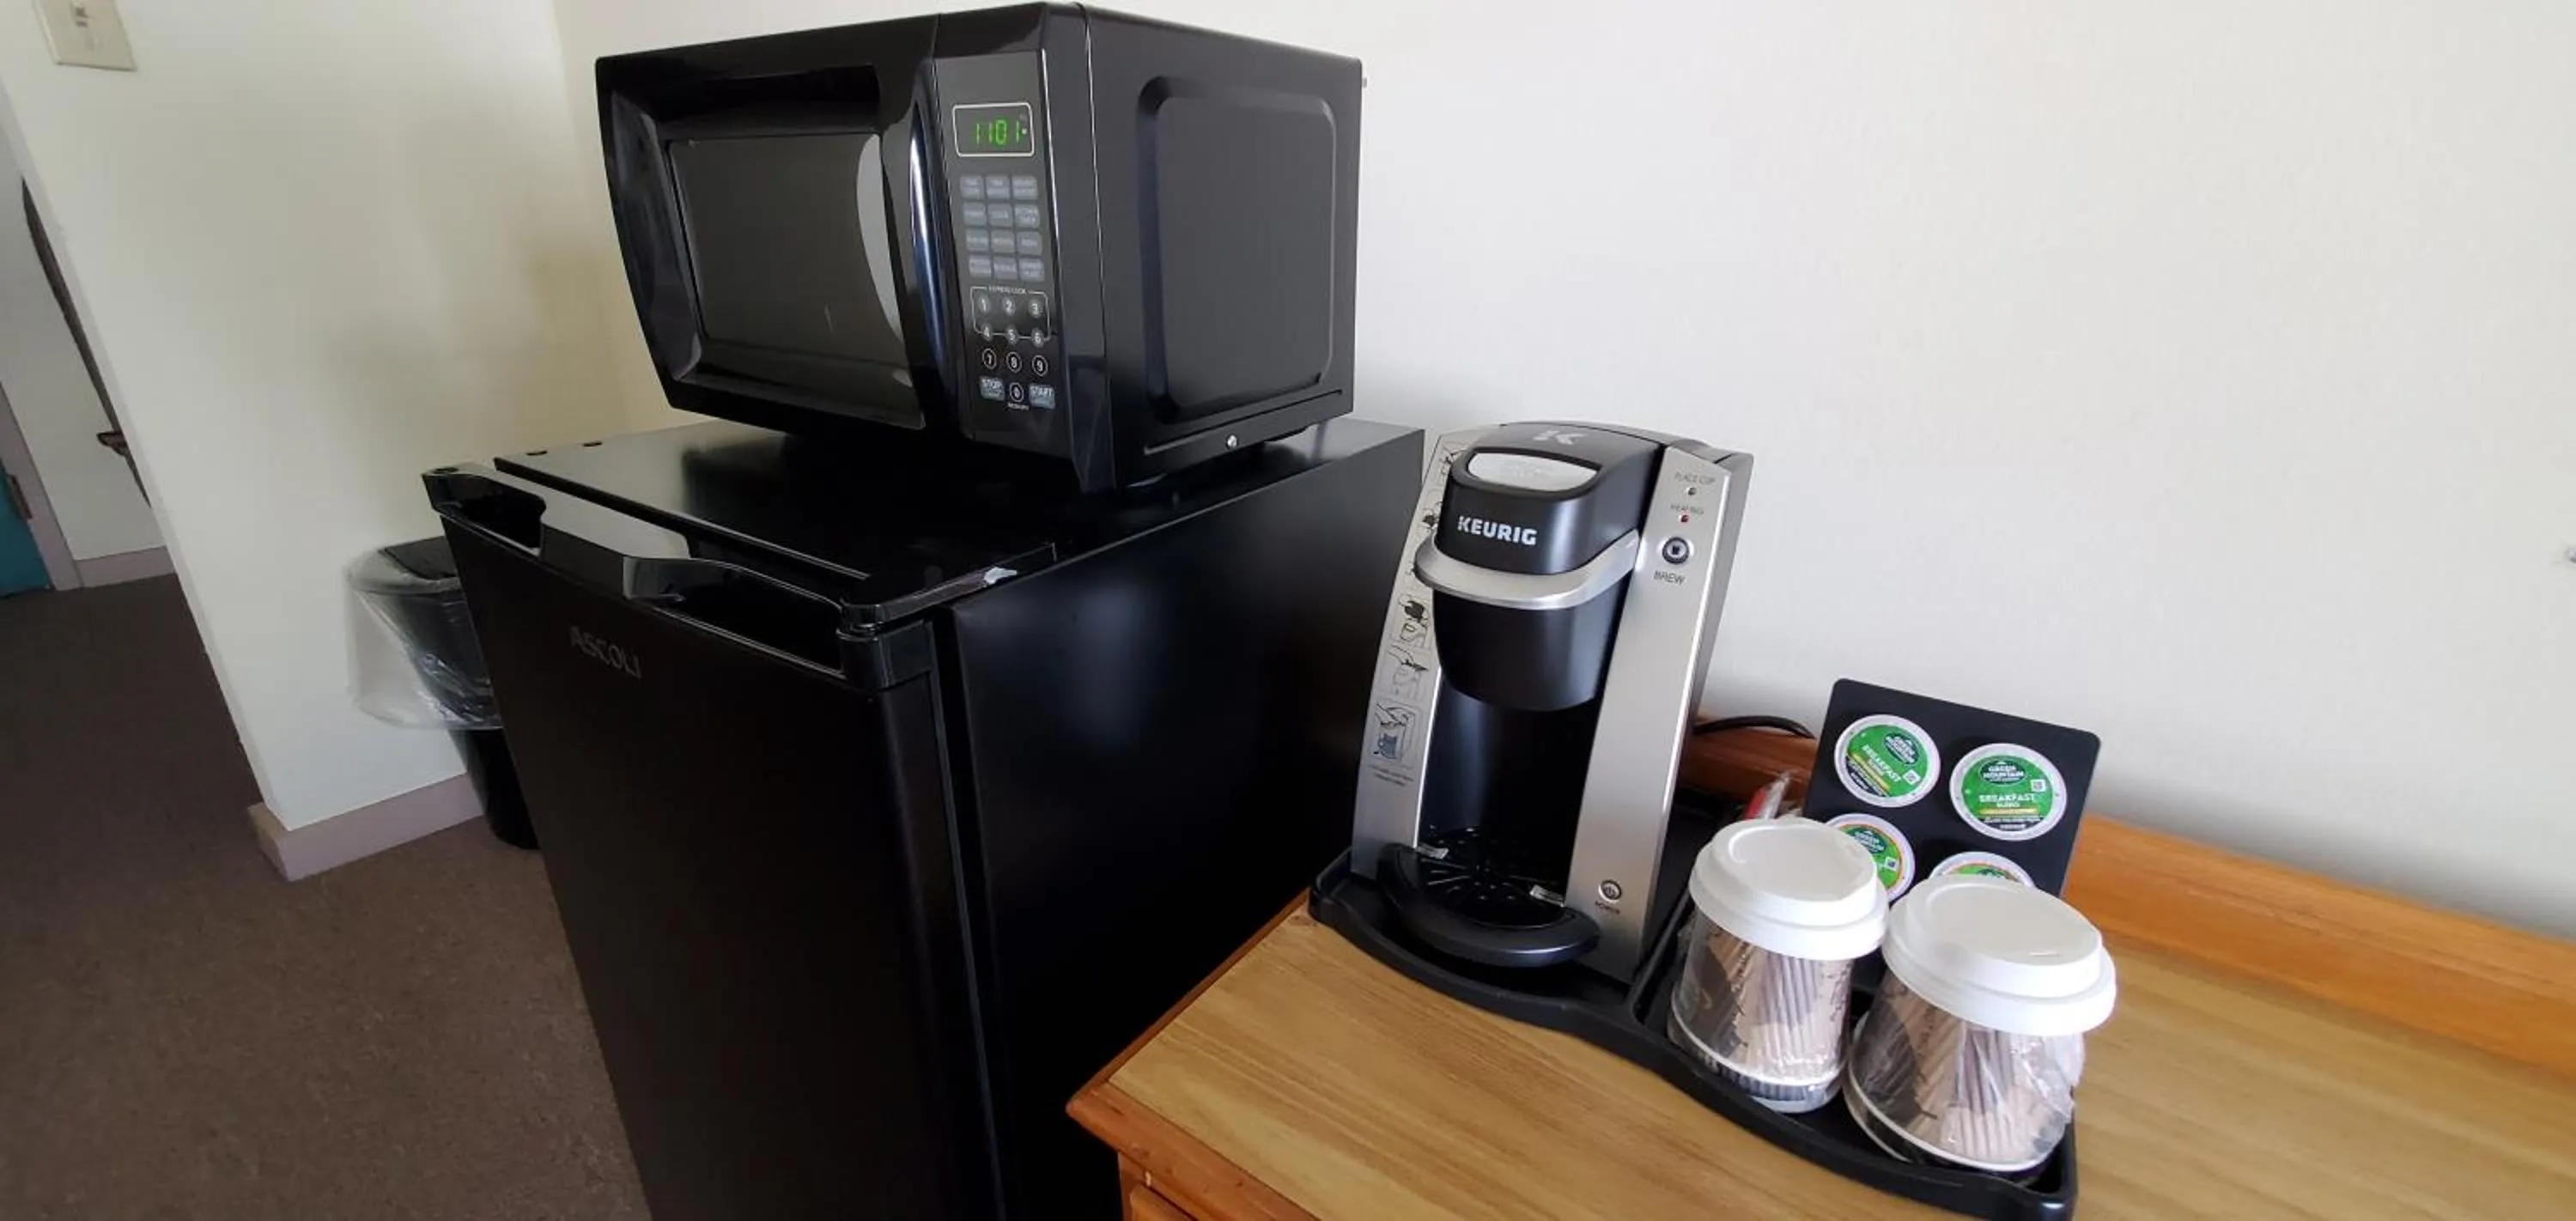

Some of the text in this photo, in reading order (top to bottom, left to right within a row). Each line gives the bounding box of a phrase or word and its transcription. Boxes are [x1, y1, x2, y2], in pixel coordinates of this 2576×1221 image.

[1030, 385, 1053, 396] START
[1457, 515, 1537, 545] KEURIG
[1654, 570, 1686, 585] BREW
[569, 625, 642, 679] ASCOLI
[1978, 793, 2036, 803] BREAKFAST
